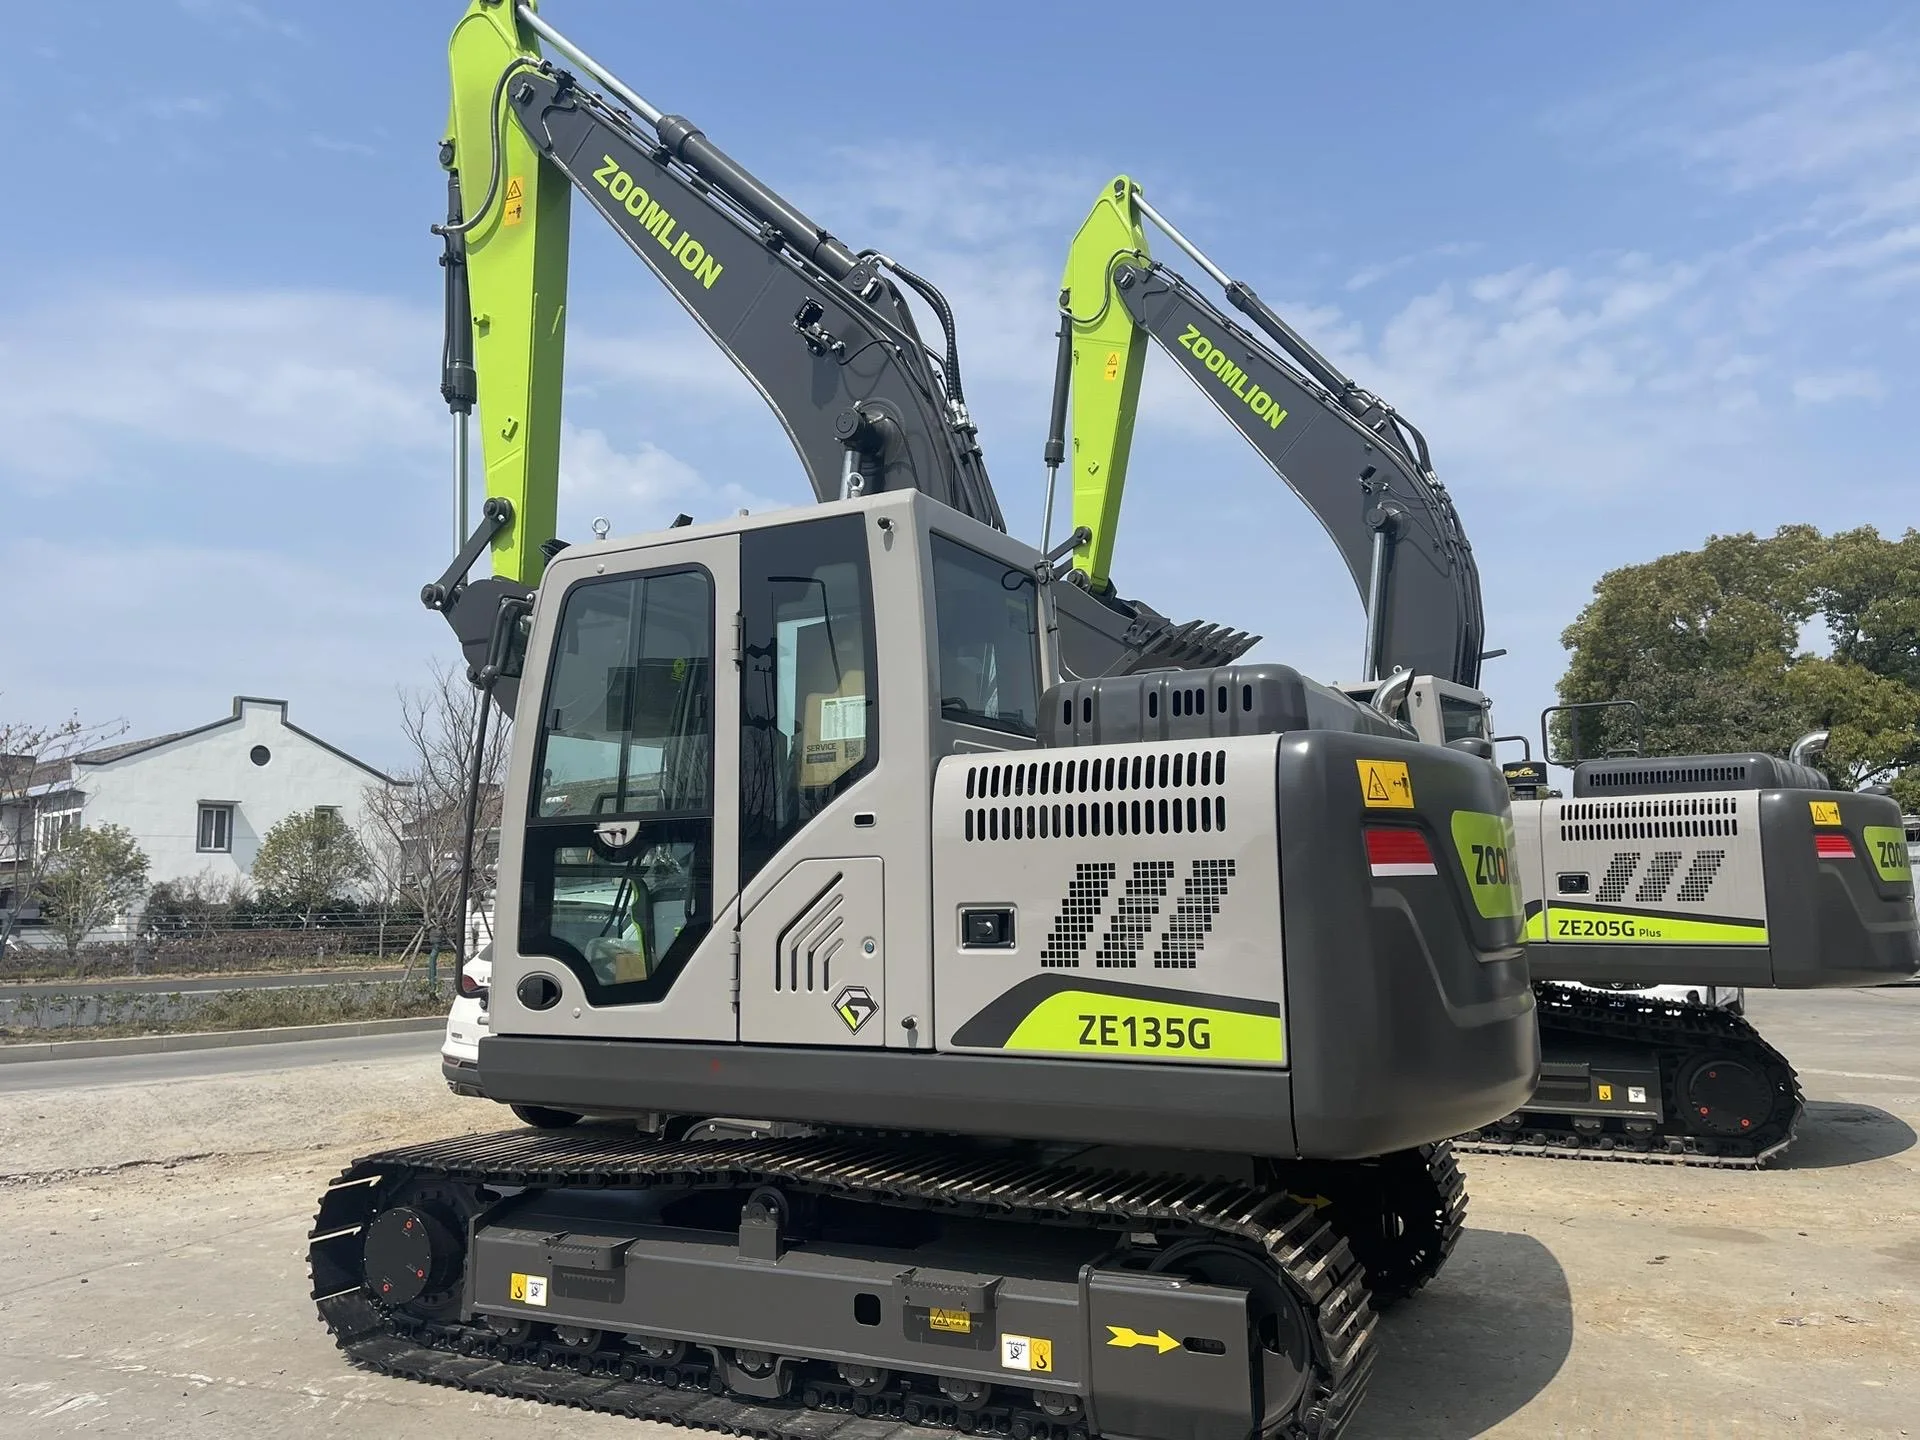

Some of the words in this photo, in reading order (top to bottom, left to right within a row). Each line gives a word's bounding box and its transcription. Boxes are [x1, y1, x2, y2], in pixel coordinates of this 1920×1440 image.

[592, 154, 723, 290] ZOOMLION
[1178, 323, 1288, 430] ZOOMLION
[806, 743, 837, 752] SERVICE
[1558, 920, 1635, 937] ZE205G
[1639, 928, 1662, 937] Plus
[1078, 1015, 1211, 1050] ZE135G
